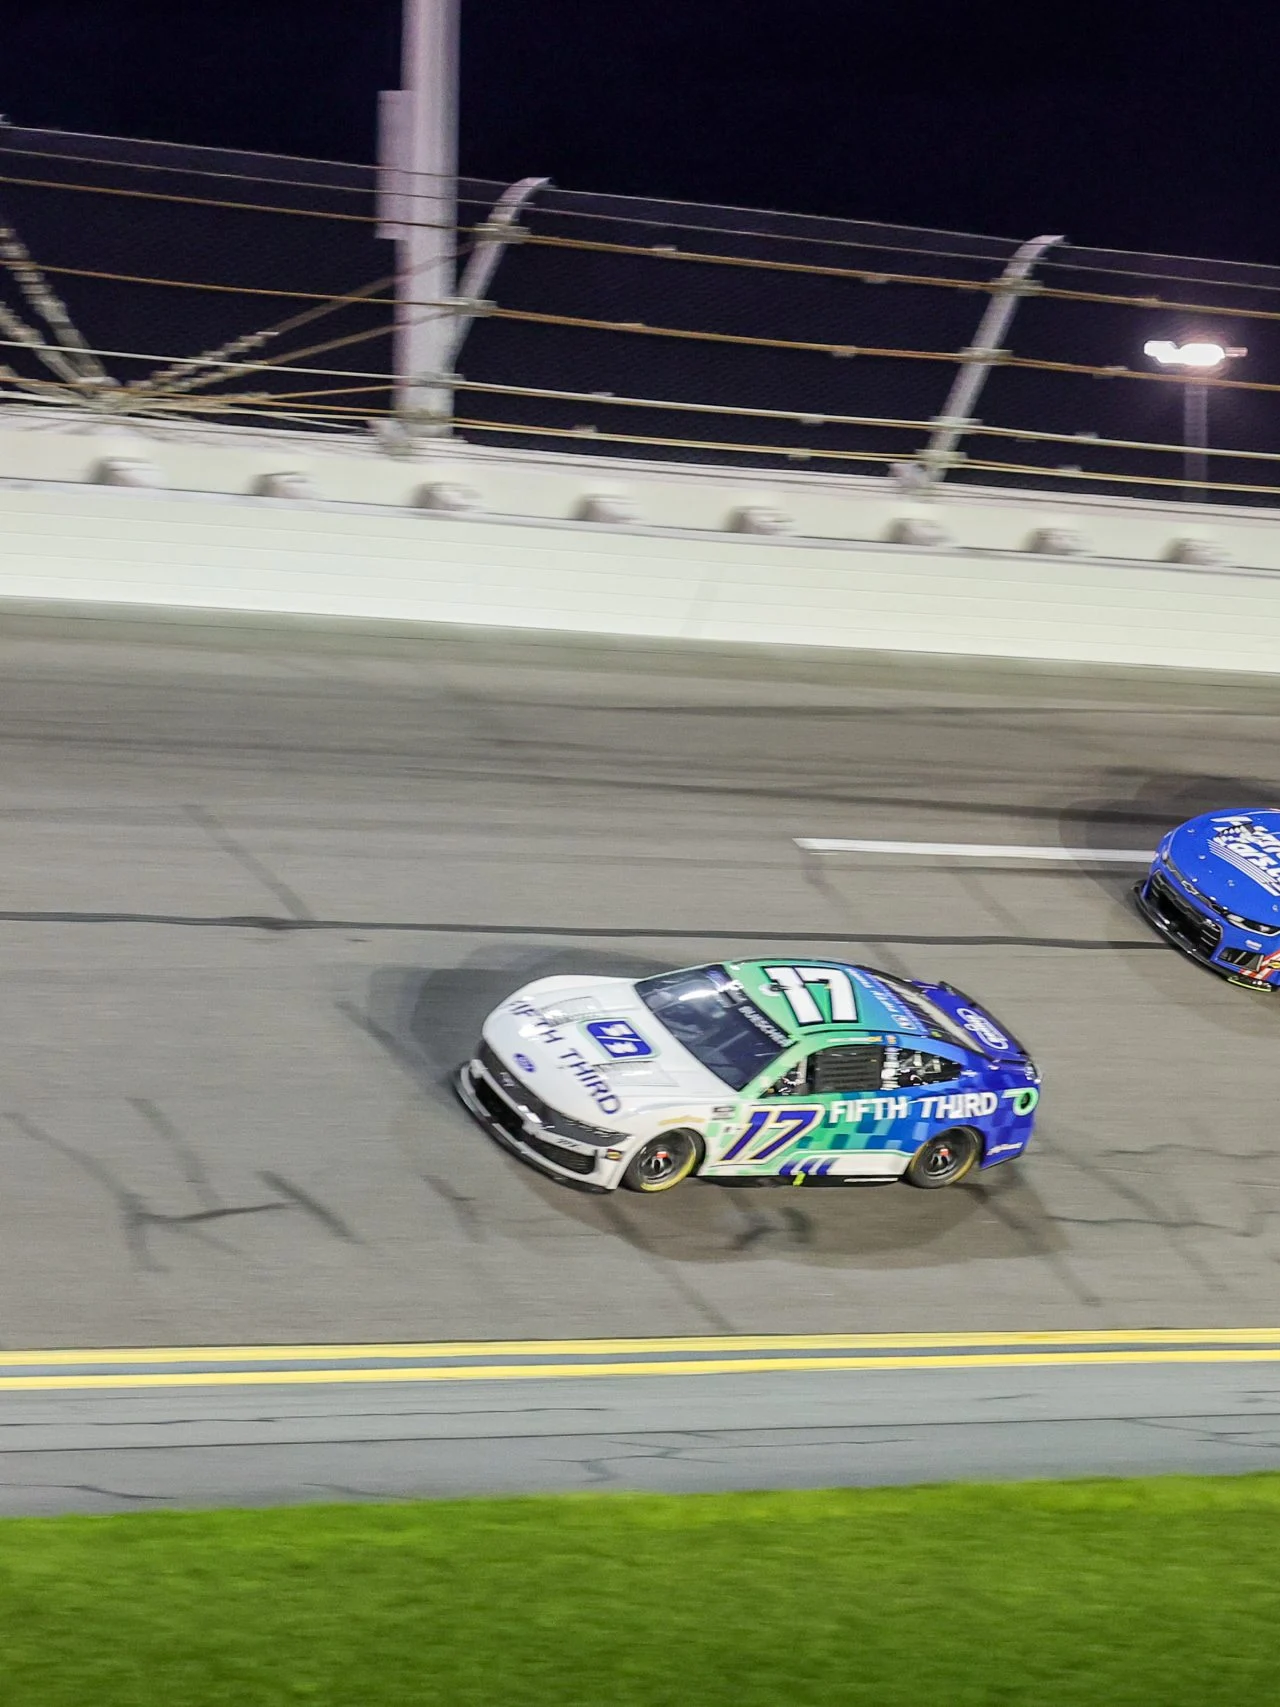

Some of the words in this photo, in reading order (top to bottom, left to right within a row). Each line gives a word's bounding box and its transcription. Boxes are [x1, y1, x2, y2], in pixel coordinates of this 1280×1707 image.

[762, 965, 860, 1026] 17
[559, 1047, 621, 1115] THIRD
[828, 1097, 909, 1124] FIFTH
[917, 1091, 999, 1120] THIRD
[714, 1106, 824, 1164] 17
